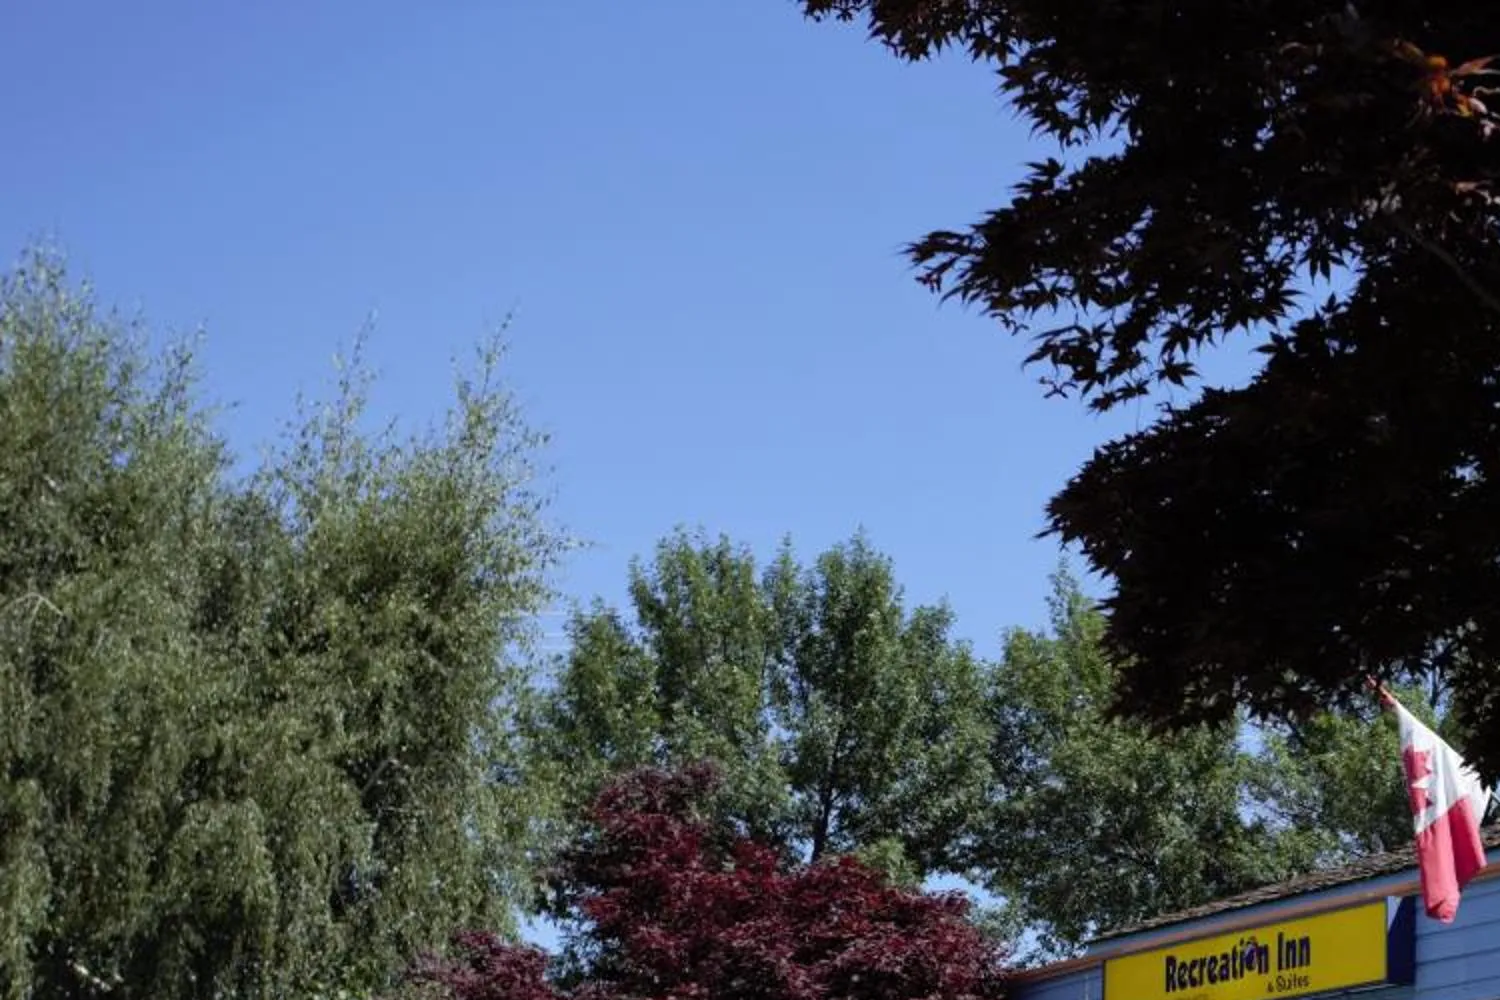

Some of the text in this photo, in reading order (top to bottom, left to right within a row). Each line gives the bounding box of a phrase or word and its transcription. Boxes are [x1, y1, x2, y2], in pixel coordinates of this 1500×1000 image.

[1165, 932, 1310, 993] Recreation Inn
[1275, 974, 1310, 992] Suites
